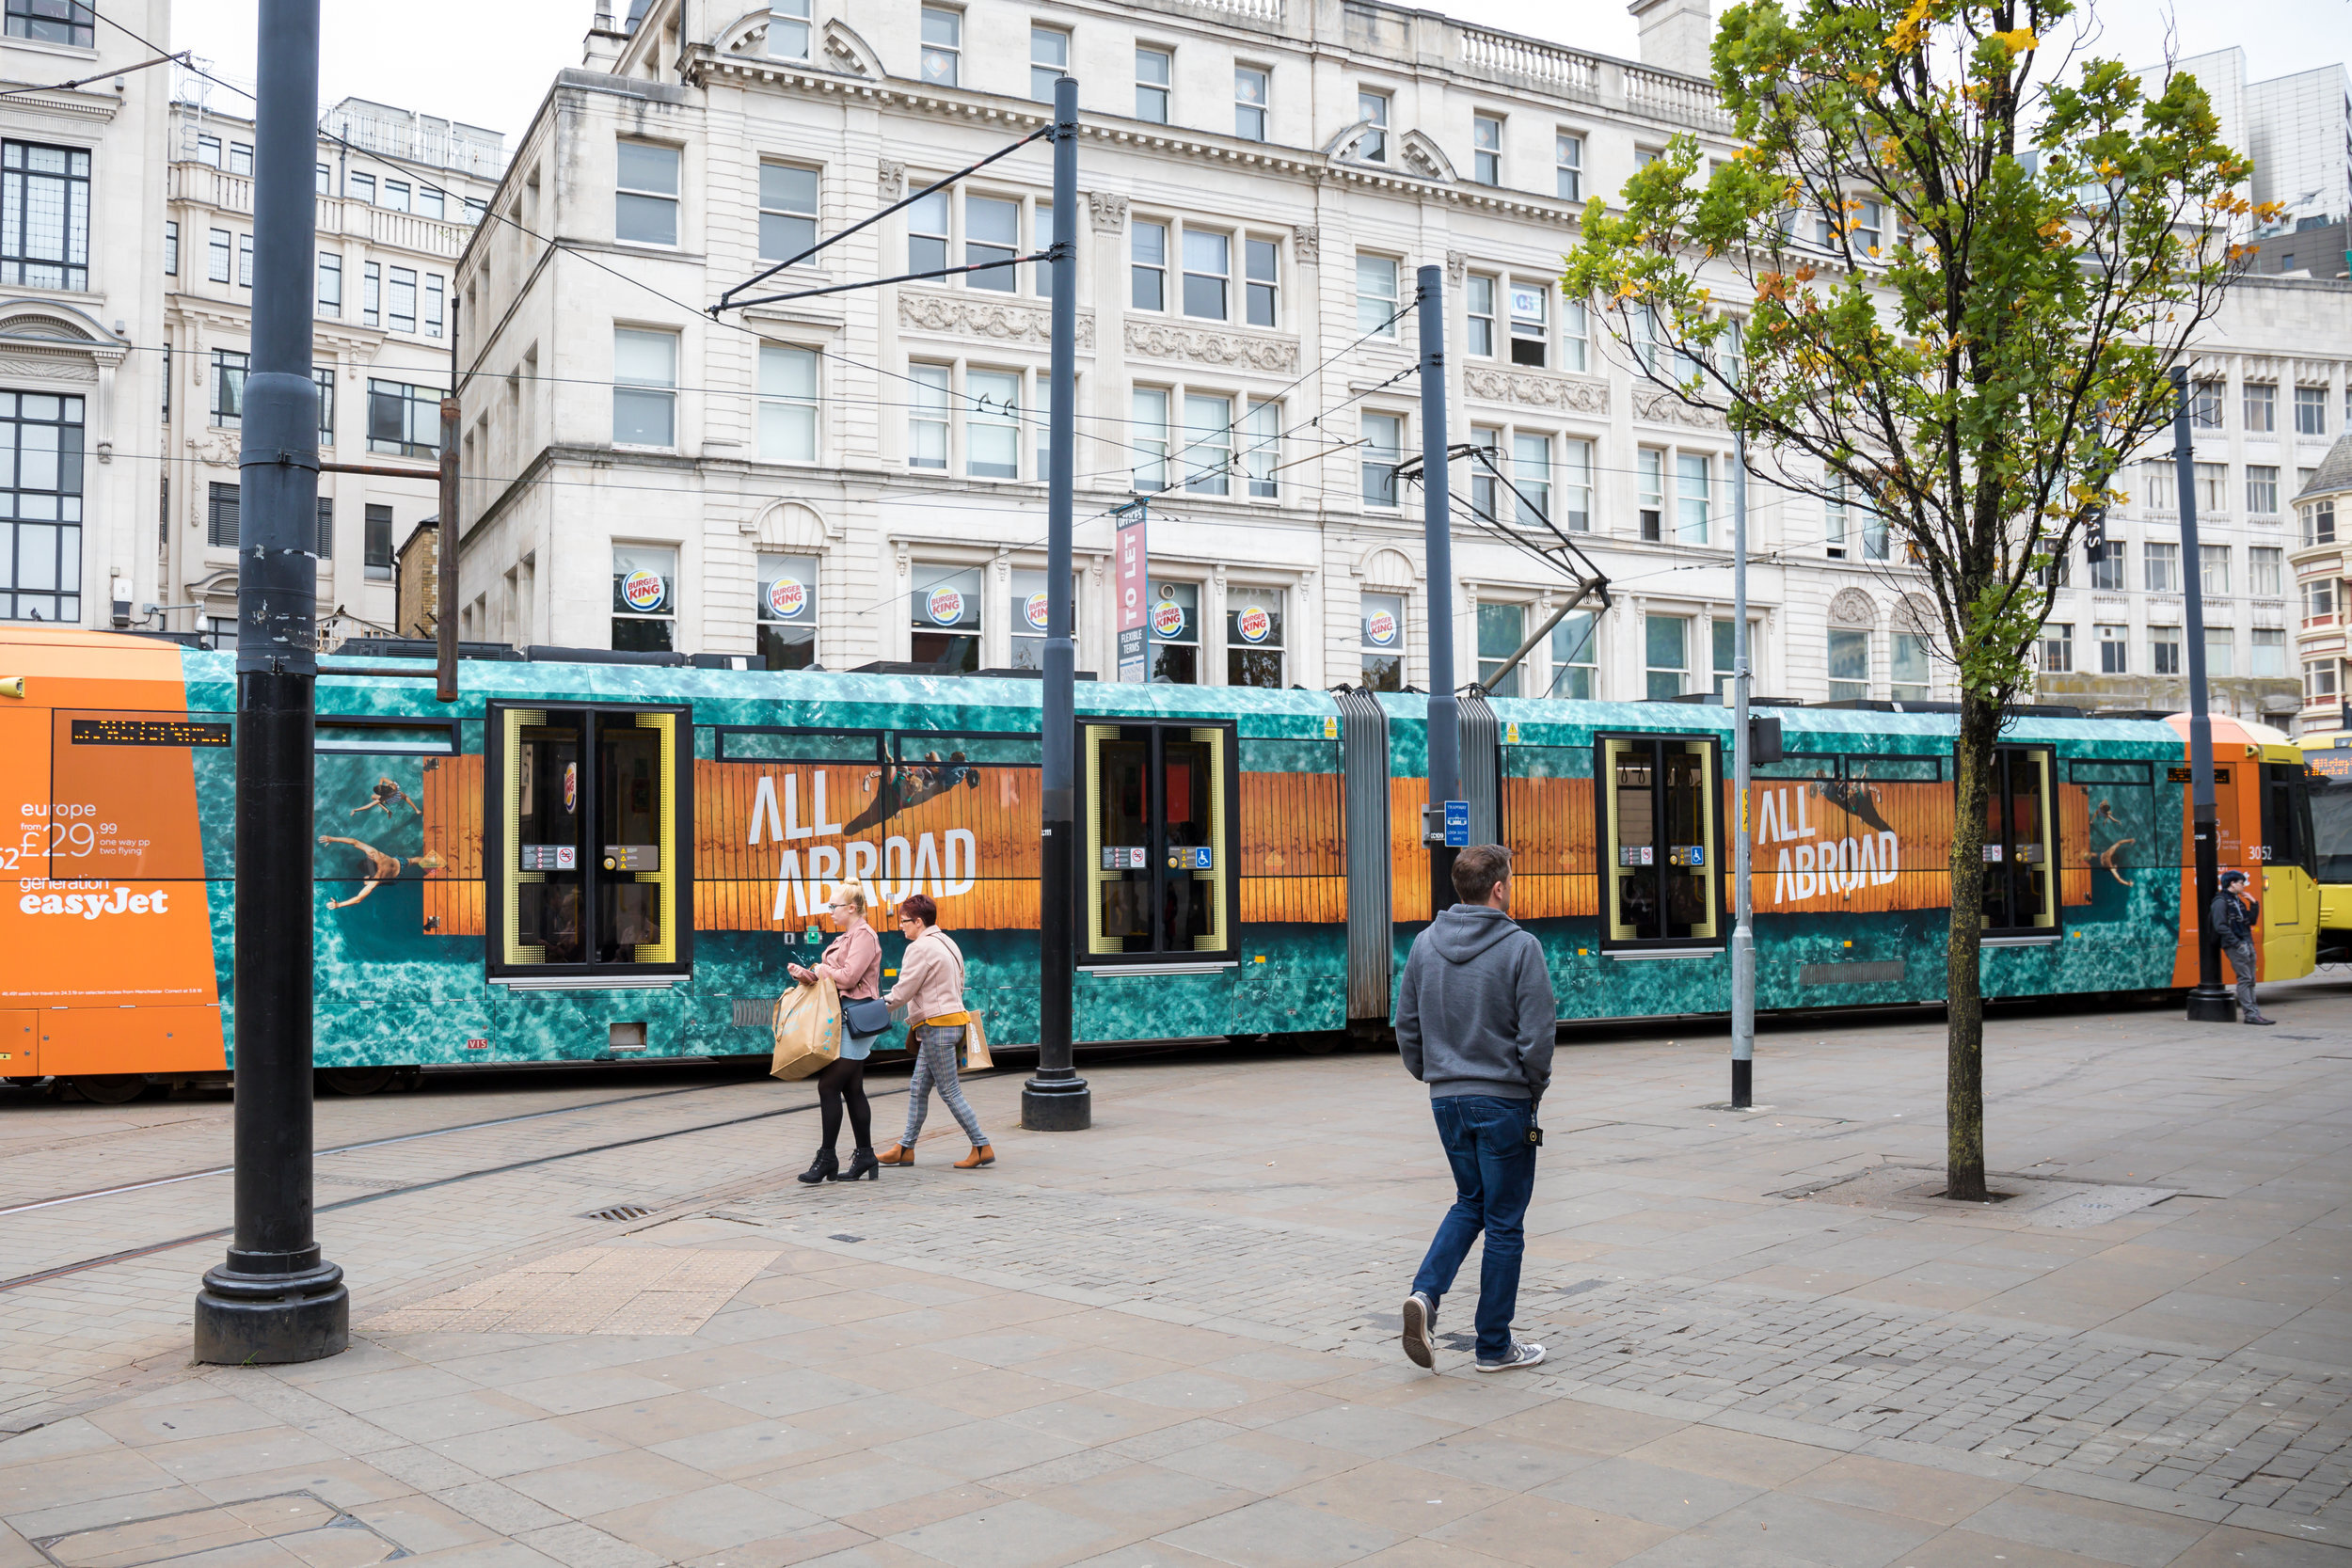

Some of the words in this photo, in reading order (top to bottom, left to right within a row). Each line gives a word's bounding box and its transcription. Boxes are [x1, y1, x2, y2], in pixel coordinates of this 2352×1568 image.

[1118, 508, 1142, 528] OFFICES
[1124, 532, 1136, 579] LET
[628, 577, 659, 591] BURGER
[771, 584, 802, 597] BURGER
[628, 584, 660, 601] KING
[773, 592, 803, 609] KING
[930, 594, 959, 607] BURGER
[932, 600, 960, 616] KING
[1028, 600, 1048, 610] BURG
[1124, 587, 1136, 626] TO
[1029, 608, 1048, 621] KIN
[1154, 608, 1180, 620] BURGER
[1155, 613, 1181, 629] KING
[1242, 612, 1265, 626] BURGER
[1370, 616, 1392, 627] BURGER
[1243, 619, 1266, 634] KING
[1371, 622, 1393, 637] KING
[1120, 629, 1142, 644] FLEXIBLE
[1123, 641, 1140, 655] TERMS
[21, 803, 97, 819] europe
[748, 770, 842, 845] ALL
[1757, 786, 1816, 846] ALL
[21, 822, 41, 831] from
[118, 847, 142, 856] flying
[2249, 846, 2272, 860] 3052
[773, 829, 976, 921] ABROAD
[1774, 832, 1899, 904] ABROAD
[19, 874, 109, 893] generation
[19, 887, 168, 920] easyJet
[469, 1039, 486, 1048] VIS
